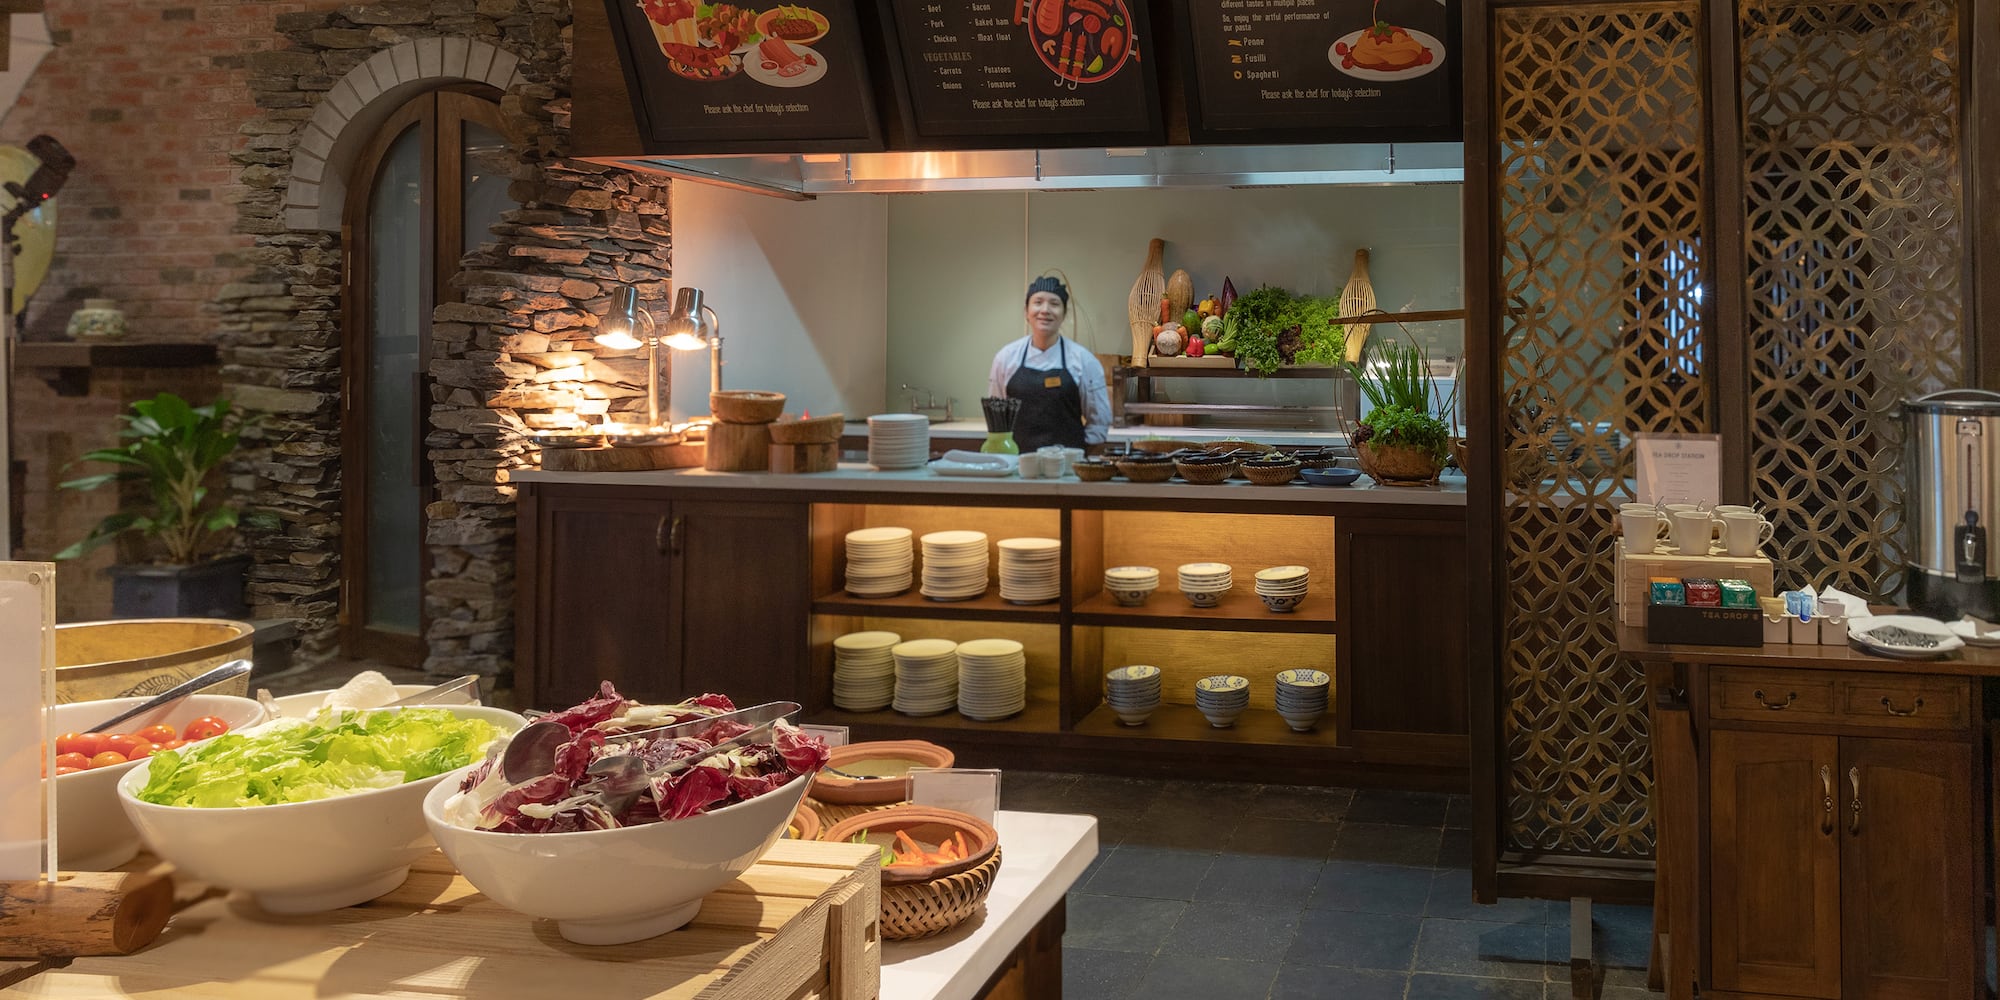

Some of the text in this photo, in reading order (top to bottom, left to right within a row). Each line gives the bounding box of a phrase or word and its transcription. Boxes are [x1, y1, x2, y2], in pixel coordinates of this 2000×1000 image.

[1234, 14, 1249, 23] enjoy
[1284, 12, 1320, 22] performance
[1323, 11, 1330, 19] of
[1235, 24, 1251, 32] pasta
[934, 35, 957, 43] Chicken
[1243, 37, 1264, 46] Penne
[923, 52, 972, 62] VEGETABLES
[1245, 54, 1266, 62] Fusilli
[984, 66, 1011, 74] Potatoes
[1247, 70, 1279, 80] Spaghetti
[987, 80, 1016, 88] Tomatoes
[1261, 88, 1381, 101] Please ask the chef for today's selection
[704, 104, 721, 113] Please
[722, 104, 733, 113] ask
[733, 104, 742, 112] the
[743, 104, 754, 112] chef
[755, 104, 763, 112] for
[785, 104, 809, 112] selection
[972, 98, 1085, 110] Please ask the chef for today's selection
[1723, 612, 1748, 620] DROP
